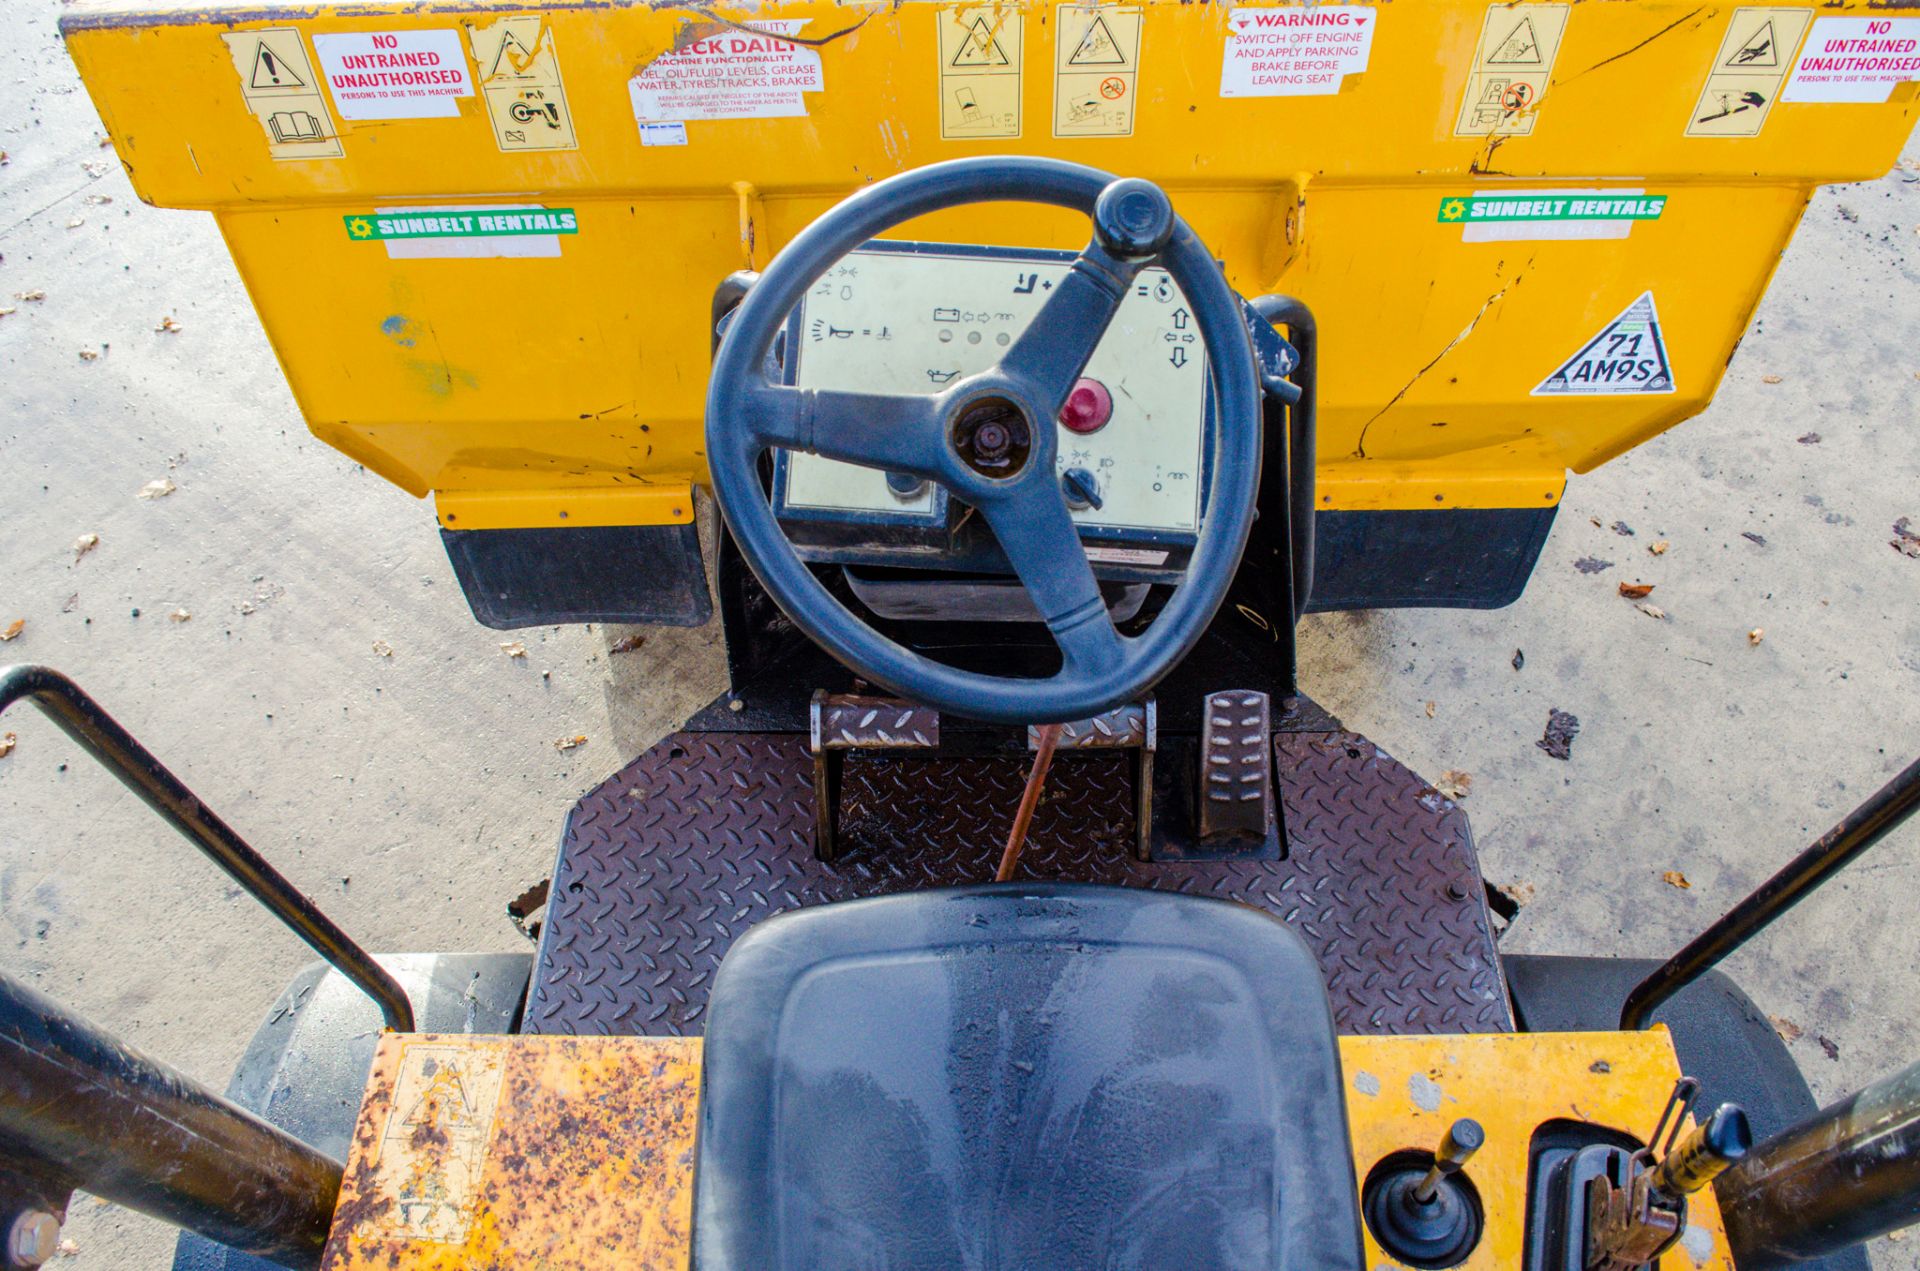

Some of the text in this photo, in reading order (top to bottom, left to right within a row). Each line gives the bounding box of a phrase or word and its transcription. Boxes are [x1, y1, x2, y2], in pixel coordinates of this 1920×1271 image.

[1256, 13, 1350, 27] WARNING
[1866, 21, 1892, 34] NO
[372, 34, 398, 48] NO
[1236, 32, 1363, 44] SWITCH OFF ENGINE
[1235, 46, 1358, 58] AND APPLY PARKING
[1824, 40, 1917, 52] UNTRAINED
[342, 52, 440, 70] UNTRAINED
[653, 55, 794, 66] MACHINE FUNCTIONALITY
[1252, 60, 1339, 72] BRAKE BEFORE
[1800, 58, 1920, 71] UNAUTHORISED
[666, 68, 724, 78] OIL/FLUID
[728, 67, 770, 76] LEVELS,
[772, 65, 816, 74] GREASE
[332, 70, 462, 88] UNAUTHORISED
[772, 77, 816, 86] BRAKES
[1252, 74, 1334, 85] LEAVING SEAT
[341, 92, 376, 100] PERSONS
[428, 88, 464, 96] MACHINE
[1470, 200, 1664, 218] SUNBELT RENTALS
[377, 214, 577, 234] SUNBELT RENTALS
[1606, 334, 1643, 358] 71
[1571, 359, 1655, 383] AM9S
